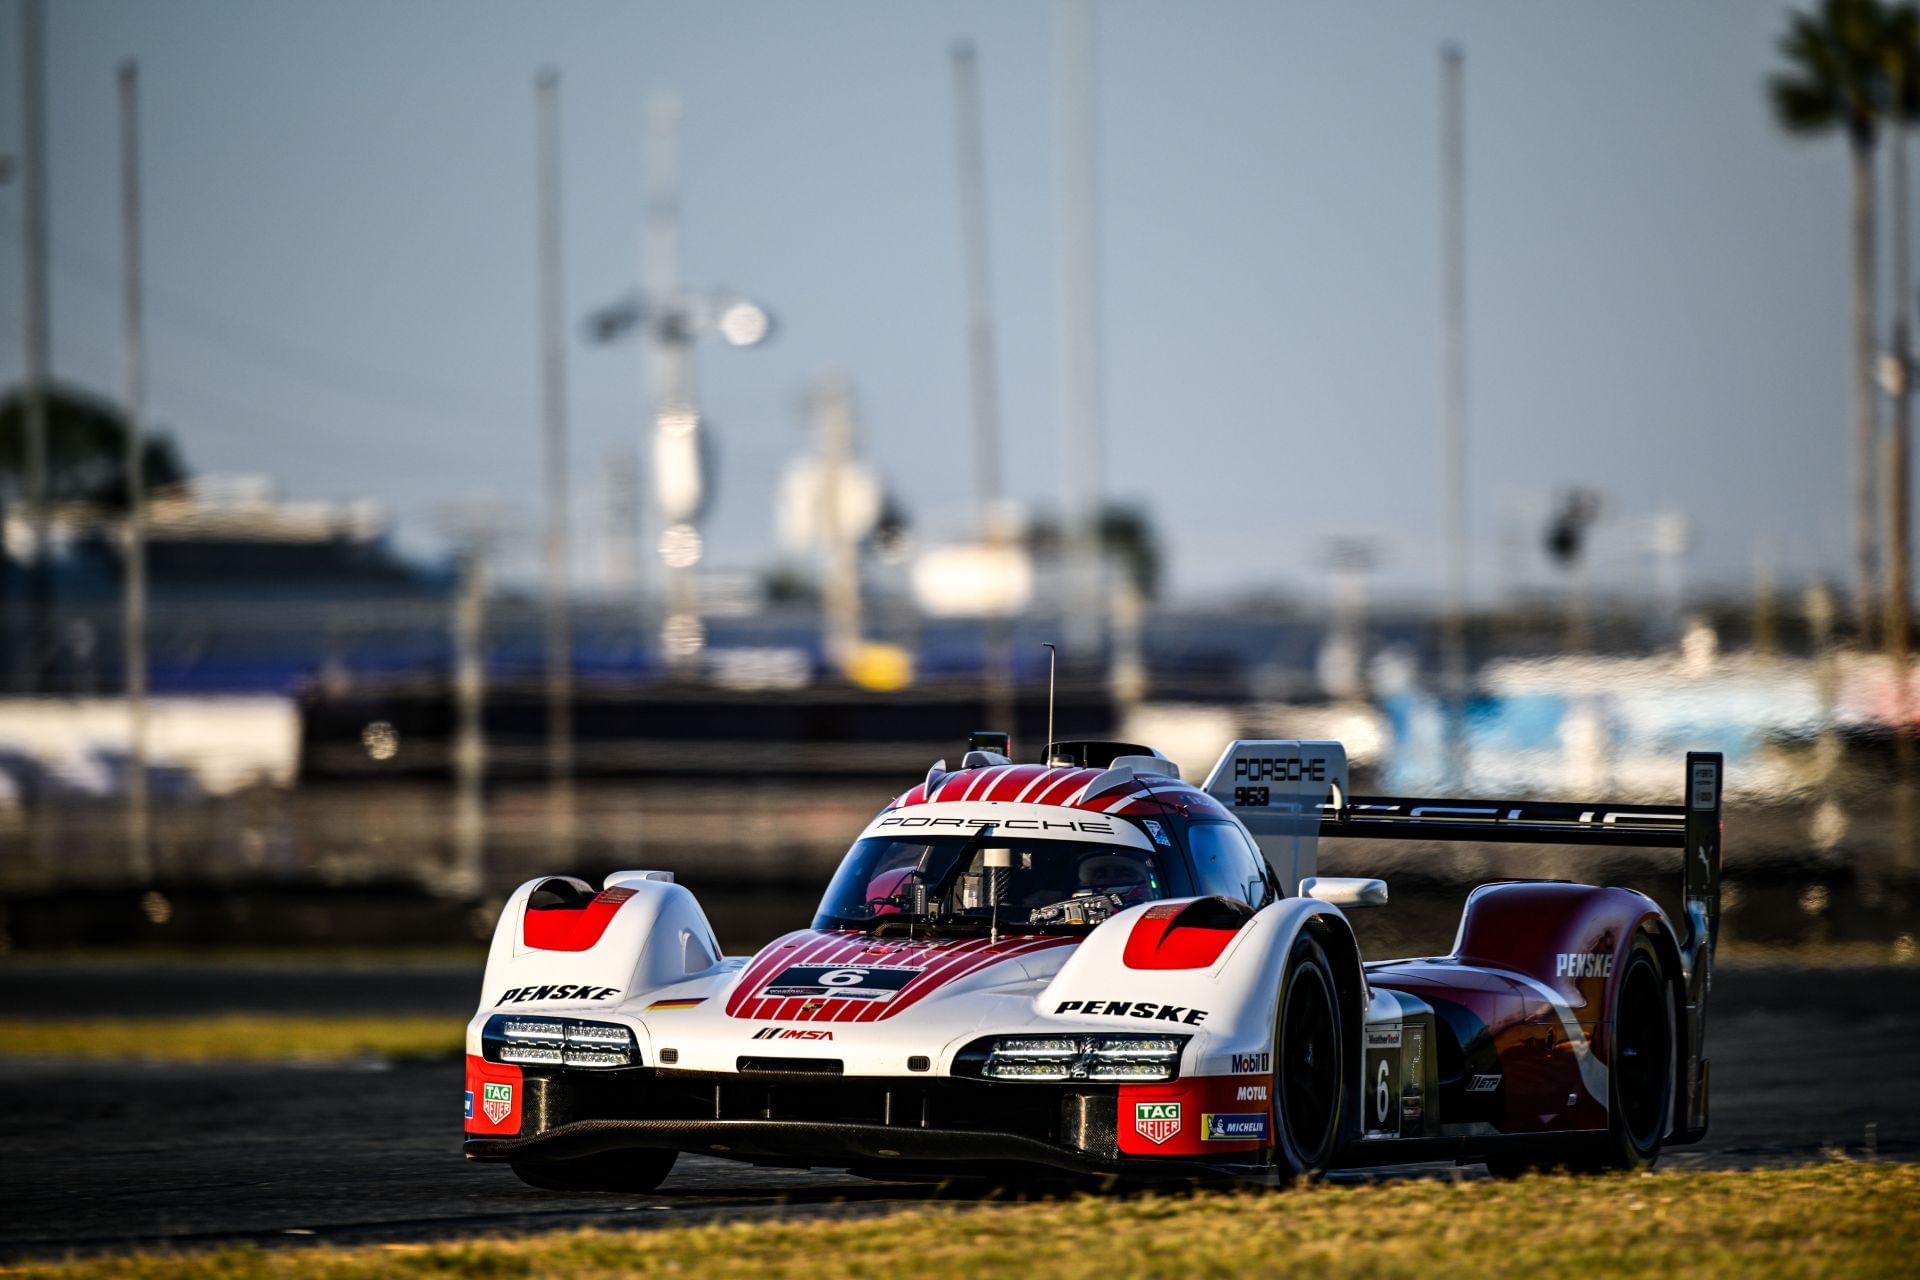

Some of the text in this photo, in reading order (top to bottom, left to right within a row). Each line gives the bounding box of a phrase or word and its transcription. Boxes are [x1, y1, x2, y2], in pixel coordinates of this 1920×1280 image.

[1235, 758, 1325, 781] PORSCHE
[1234, 786, 1269, 807] 963
[876, 816, 1115, 836] PORSCHE
[1556, 953, 1613, 978] PENSKE
[818, 969, 870, 986] 6
[495, 985, 621, 1007] PENSKE
[1055, 1000, 1209, 1026] PENSKE
[778, 1029, 834, 1041] IMSA
[1231, 1054, 1260, 1073] Mobil
[487, 1086, 509, 1100] TAG
[1236, 1085, 1267, 1101] MOTUL
[1376, 1059, 1390, 1123] 6
[484, 1101, 510, 1121] HEUER
[1139, 1104, 1178, 1119] TAG
[1138, 1120, 1180, 1143] HEUER
[1226, 1122, 1264, 1133] MICHELIN
